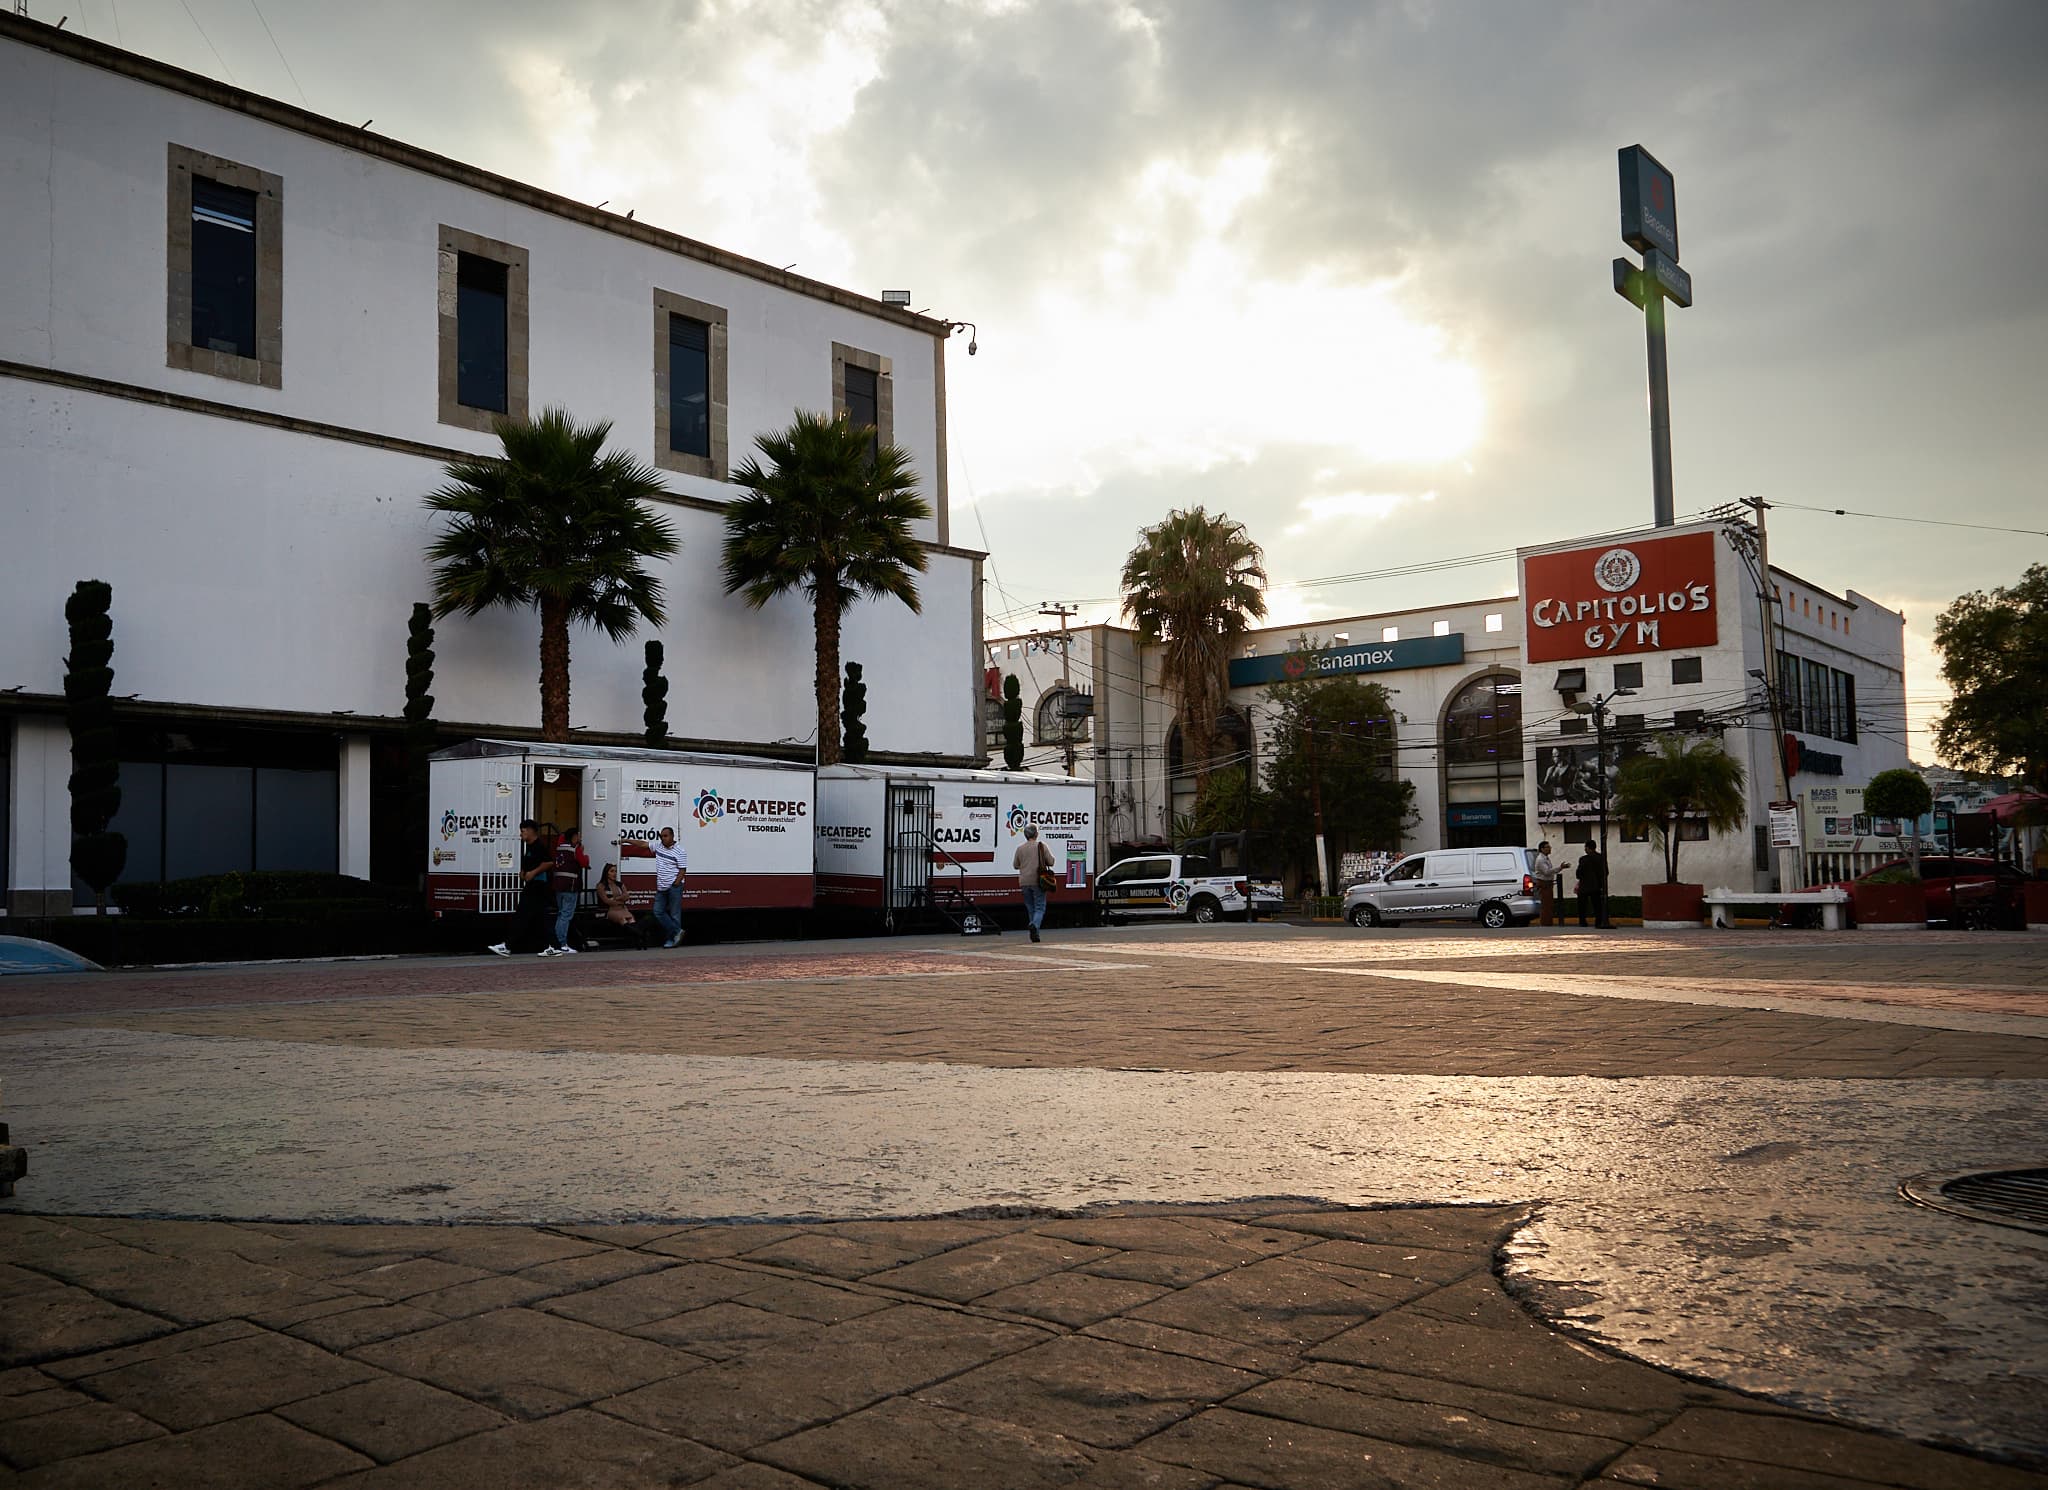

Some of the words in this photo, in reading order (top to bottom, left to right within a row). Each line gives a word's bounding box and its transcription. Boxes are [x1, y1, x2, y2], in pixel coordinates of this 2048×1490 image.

[1584, 620, 1660, 651] GYM
[1309, 650, 1394, 671] Banamex
[1811, 788, 1838, 796] MASS
[726, 798, 807, 817] ECATEPEC
[621, 813, 648, 824] EDIO
[1030, 811, 1089, 825] ECATEPEC
[621, 827, 662, 841] DACIÓN
[747, 824, 786, 833] TESORERÍA
[821, 825, 872, 838] ECATEPEC
[934, 828, 981, 843] CAJAS
[1045, 831, 1074, 840] TESORERÍA
[1098, 888, 1119, 897] POLICÍA
[1130, 888, 1161, 897] MUNICIPAL
